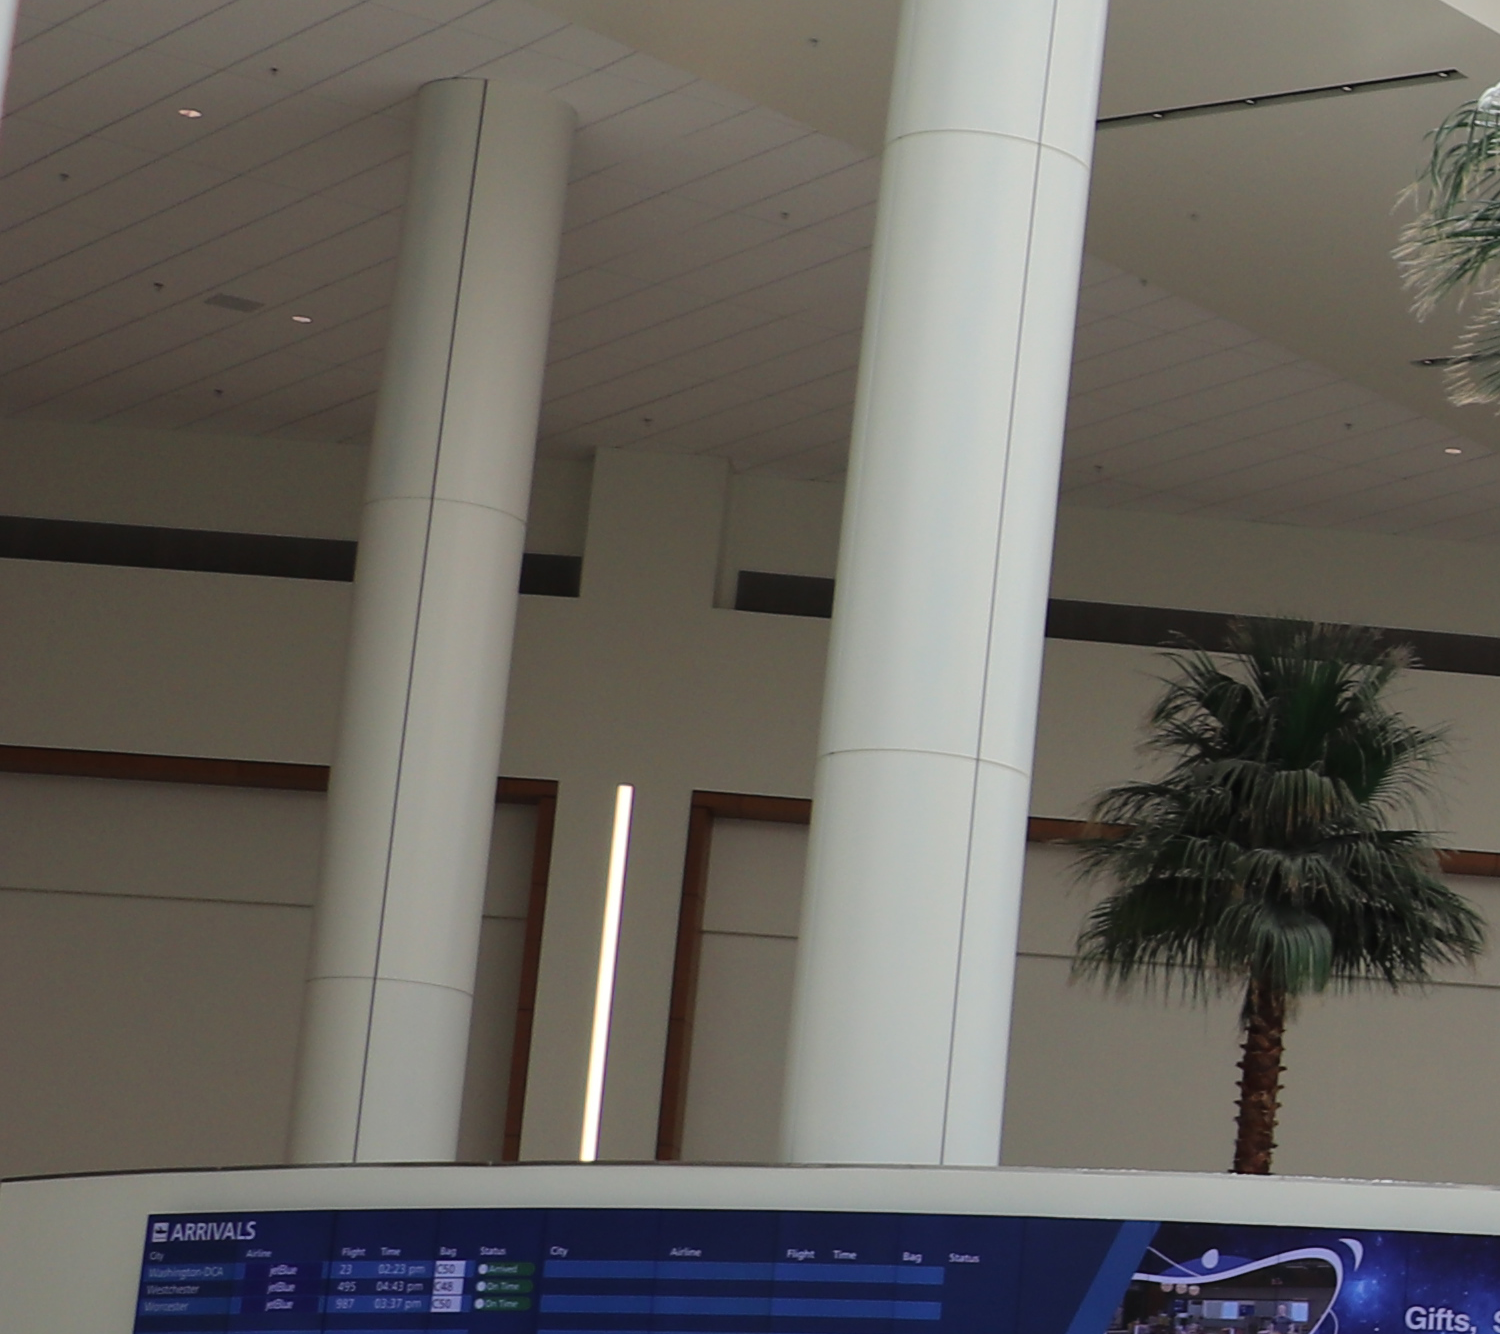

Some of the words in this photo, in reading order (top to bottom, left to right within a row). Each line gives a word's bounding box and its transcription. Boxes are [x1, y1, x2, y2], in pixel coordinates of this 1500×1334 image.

[169, 1221, 257, 1242] ARRIVALS
[149, 1252, 165, 1263] City
[246, 1249, 272, 1259] Airline
[341, 1247, 366, 1258] Flight
[381, 1246, 401, 1257] Time
[440, 1246, 458, 1258] Bag
[480, 1246, 507, 1257] Status
[550, 1246, 568, 1258] City
[670, 1247, 702, 1258] Airline
[786, 1247, 815, 1261] Flight
[833, 1249, 857, 1261] Time
[903, 1251, 923, 1264] Bag
[949, 1252, 980, 1264] Status
[339, 1264, 353, 1275] 23
[378, 1264, 407, 1275] 02:23
[408, 1266, 426, 1277] pm
[146, 1284, 201, 1297] Westchester
[337, 1281, 356, 1292] 495
[376, 1281, 405, 1292] 04:43
[406, 1284, 424, 1294] pm
[486, 1281, 500, 1291] On
[501, 1282, 520, 1291] Time
[335, 1298, 355, 1309] 987
[373, 1298, 402, 1309] 03:37
[403, 1300, 422, 1311] pm
[485, 1299, 499, 1308] On
[500, 1299, 519, 1309] Time
